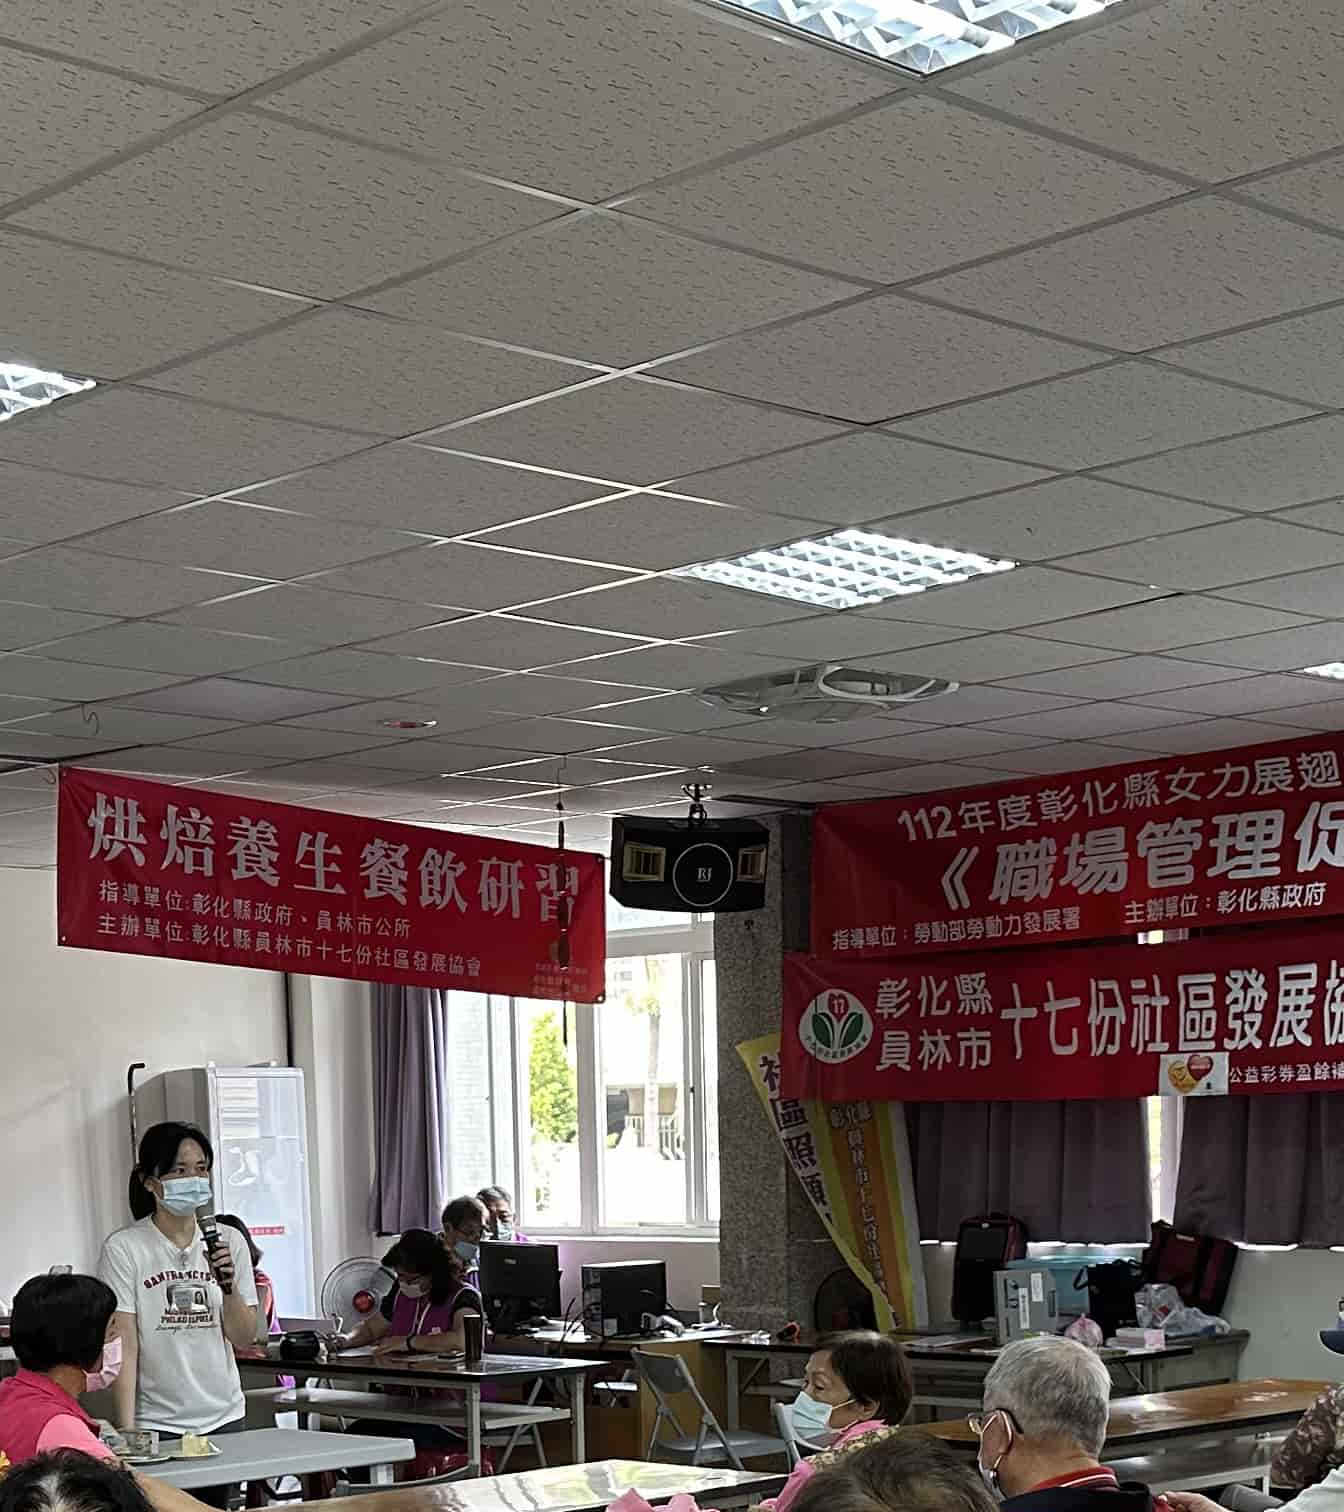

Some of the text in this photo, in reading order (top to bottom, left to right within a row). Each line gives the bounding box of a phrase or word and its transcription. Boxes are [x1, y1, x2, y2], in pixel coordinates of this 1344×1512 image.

[87, 791, 580, 924] 烘焙養生餐飲研習
[875, 972, 994, 1021] 彰化縣
[874, 1026, 994, 1073] 員林市
